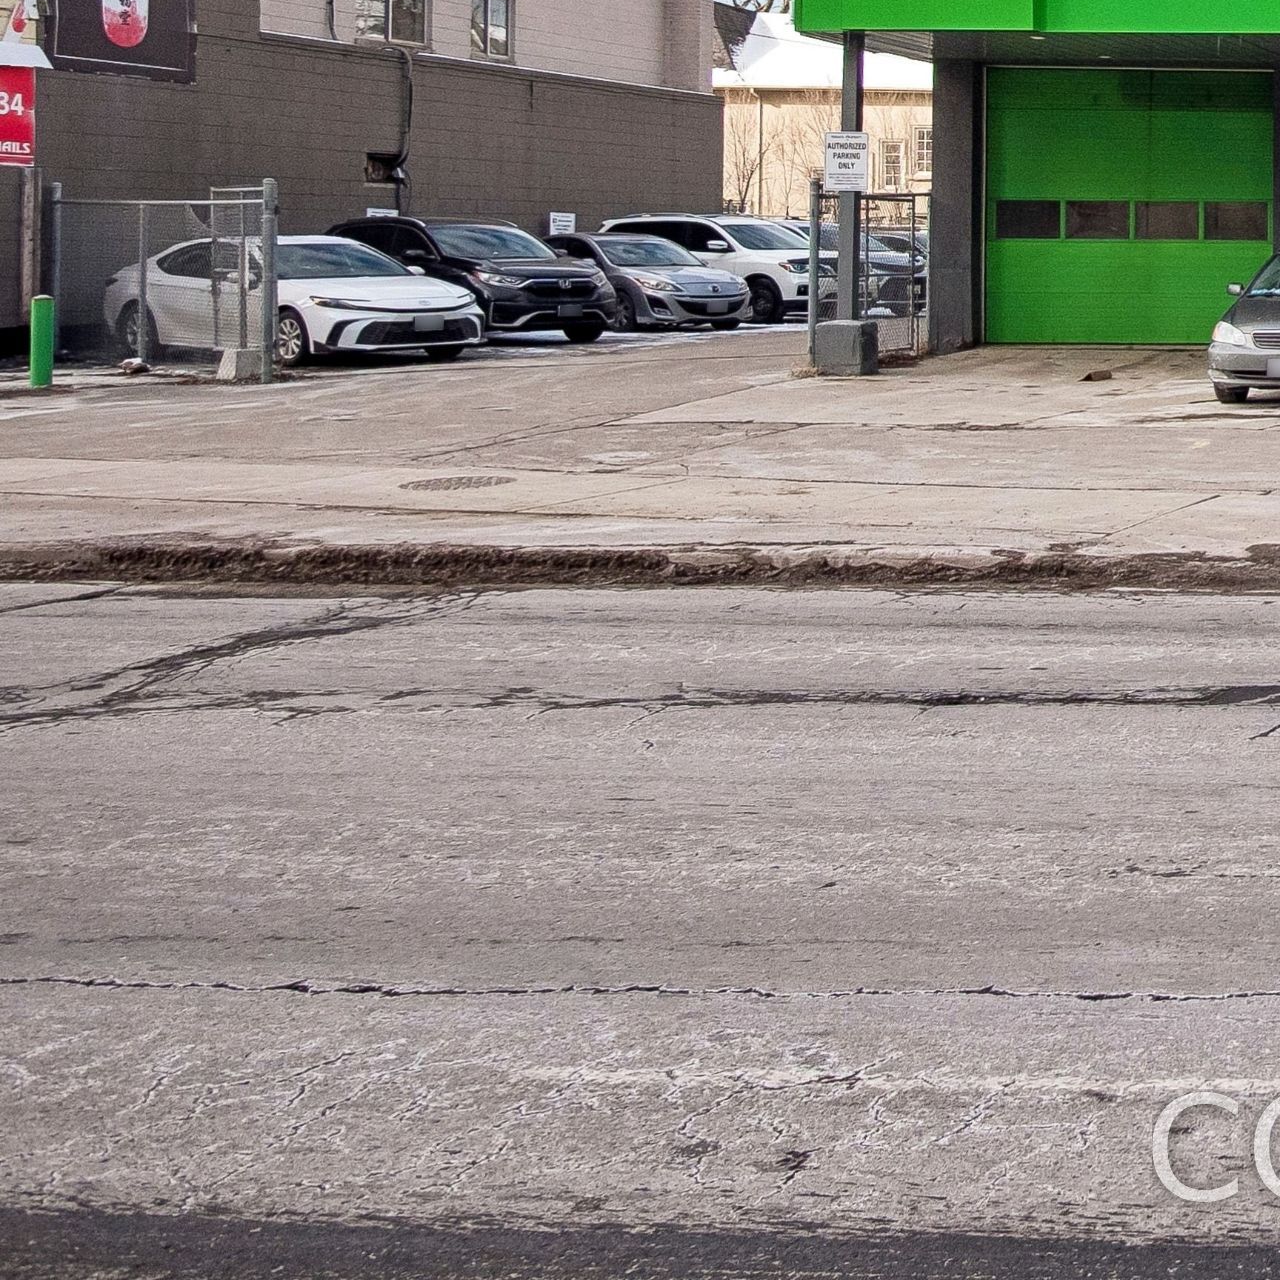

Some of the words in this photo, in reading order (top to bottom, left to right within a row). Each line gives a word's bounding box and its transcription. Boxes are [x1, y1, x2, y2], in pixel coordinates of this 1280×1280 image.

[827, 142, 867, 150] AUTHORIZED
[832, 152, 861, 160] PARKING
[838, 161, 856, 170] ONLY
